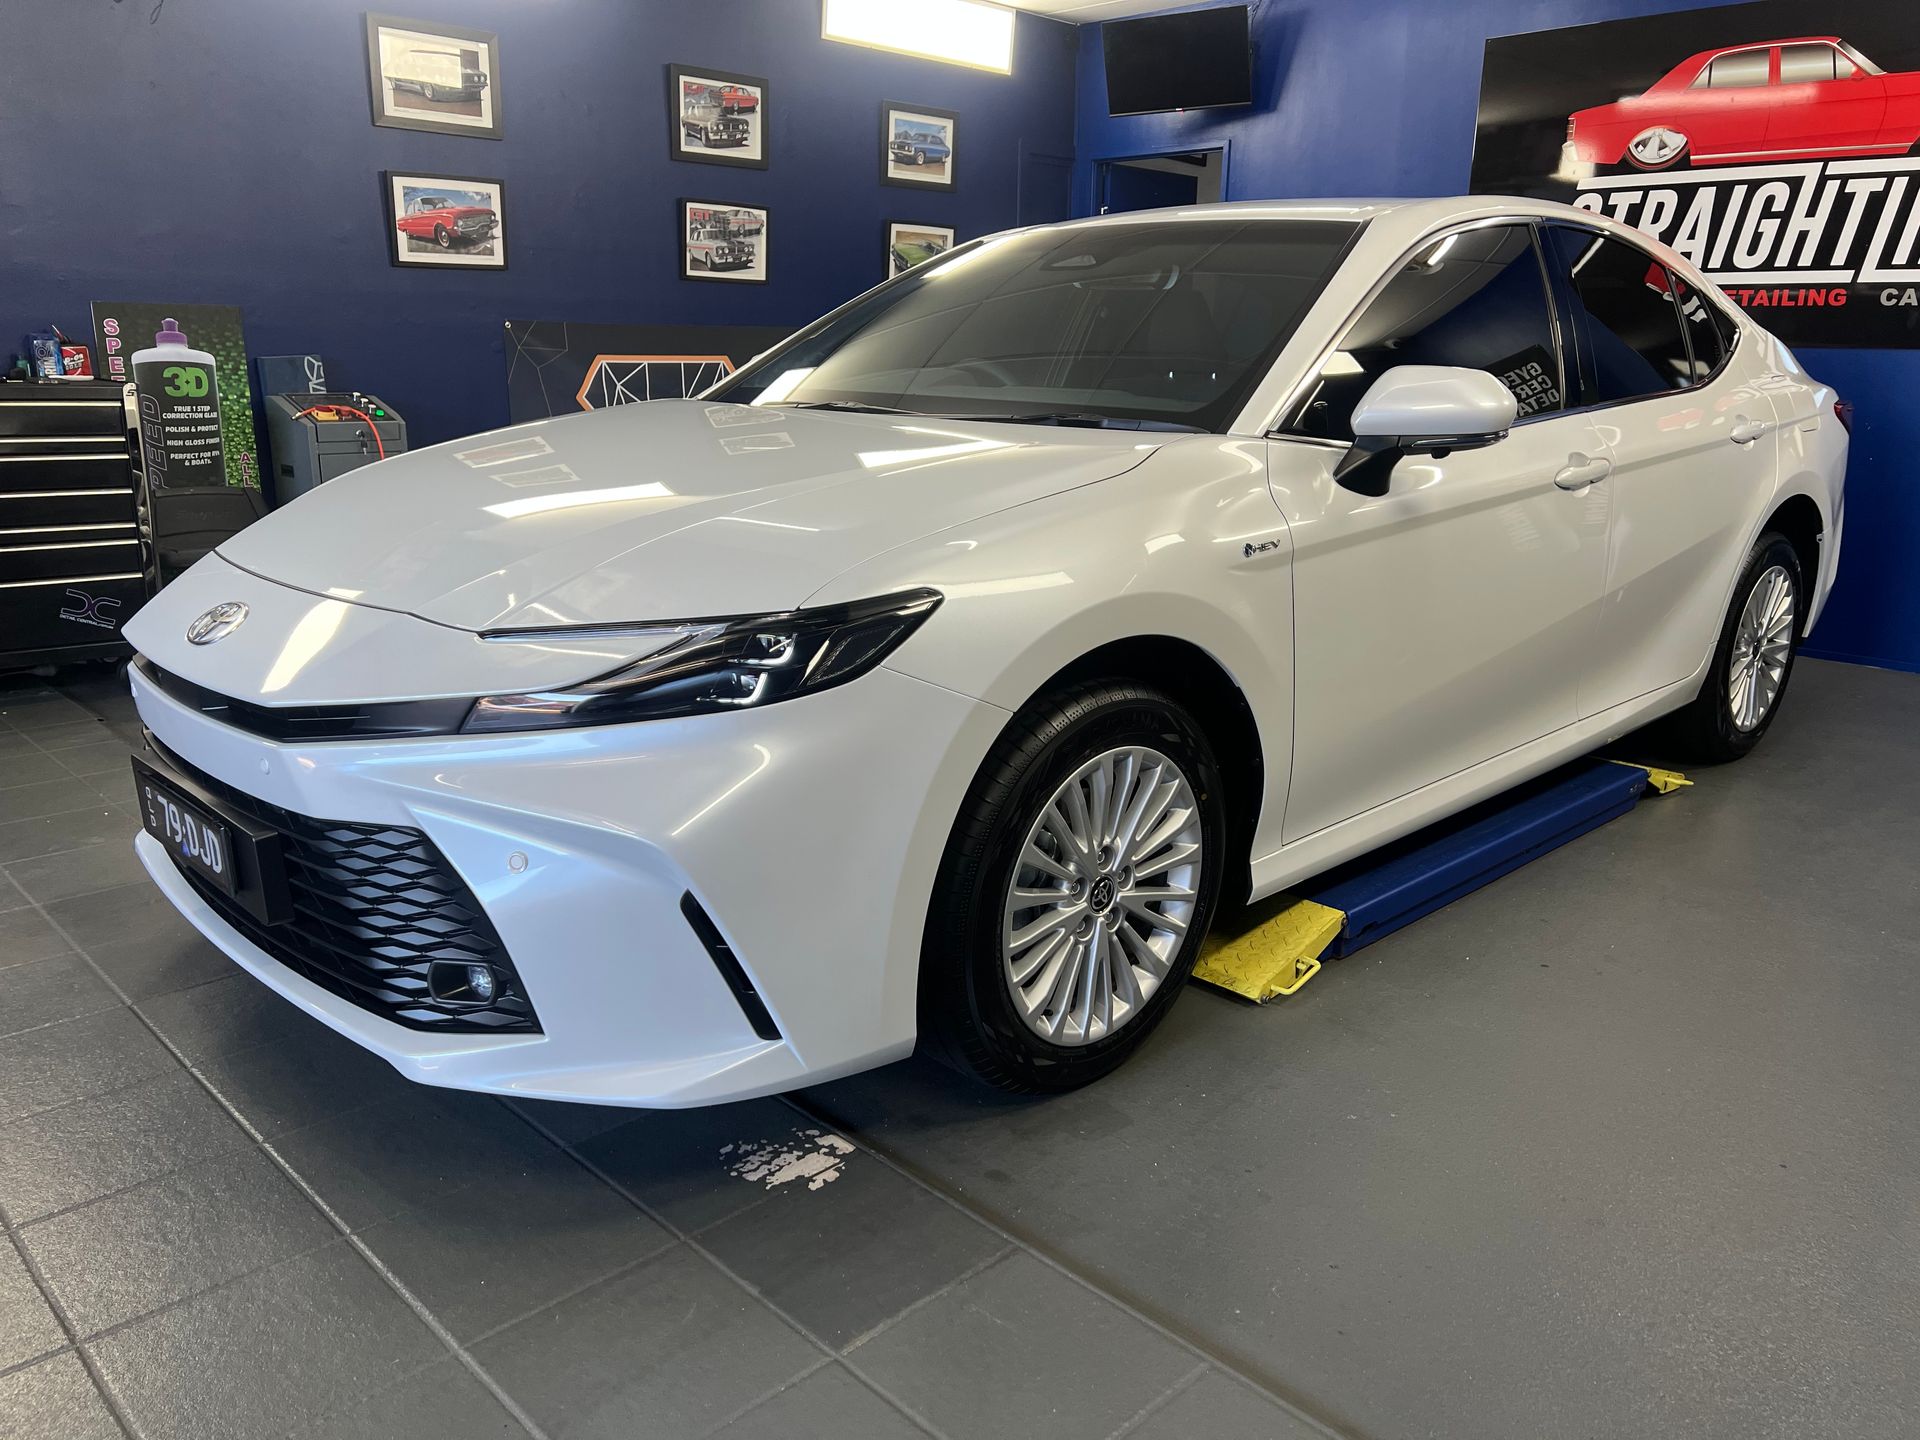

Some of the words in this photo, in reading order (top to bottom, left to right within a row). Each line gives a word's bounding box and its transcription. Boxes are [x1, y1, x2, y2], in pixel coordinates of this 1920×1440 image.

[1572, 163, 1920, 283] TRAIGHTLI
[1880, 287, 1918, 306] CA
[163, 366, 208, 397] 3D
